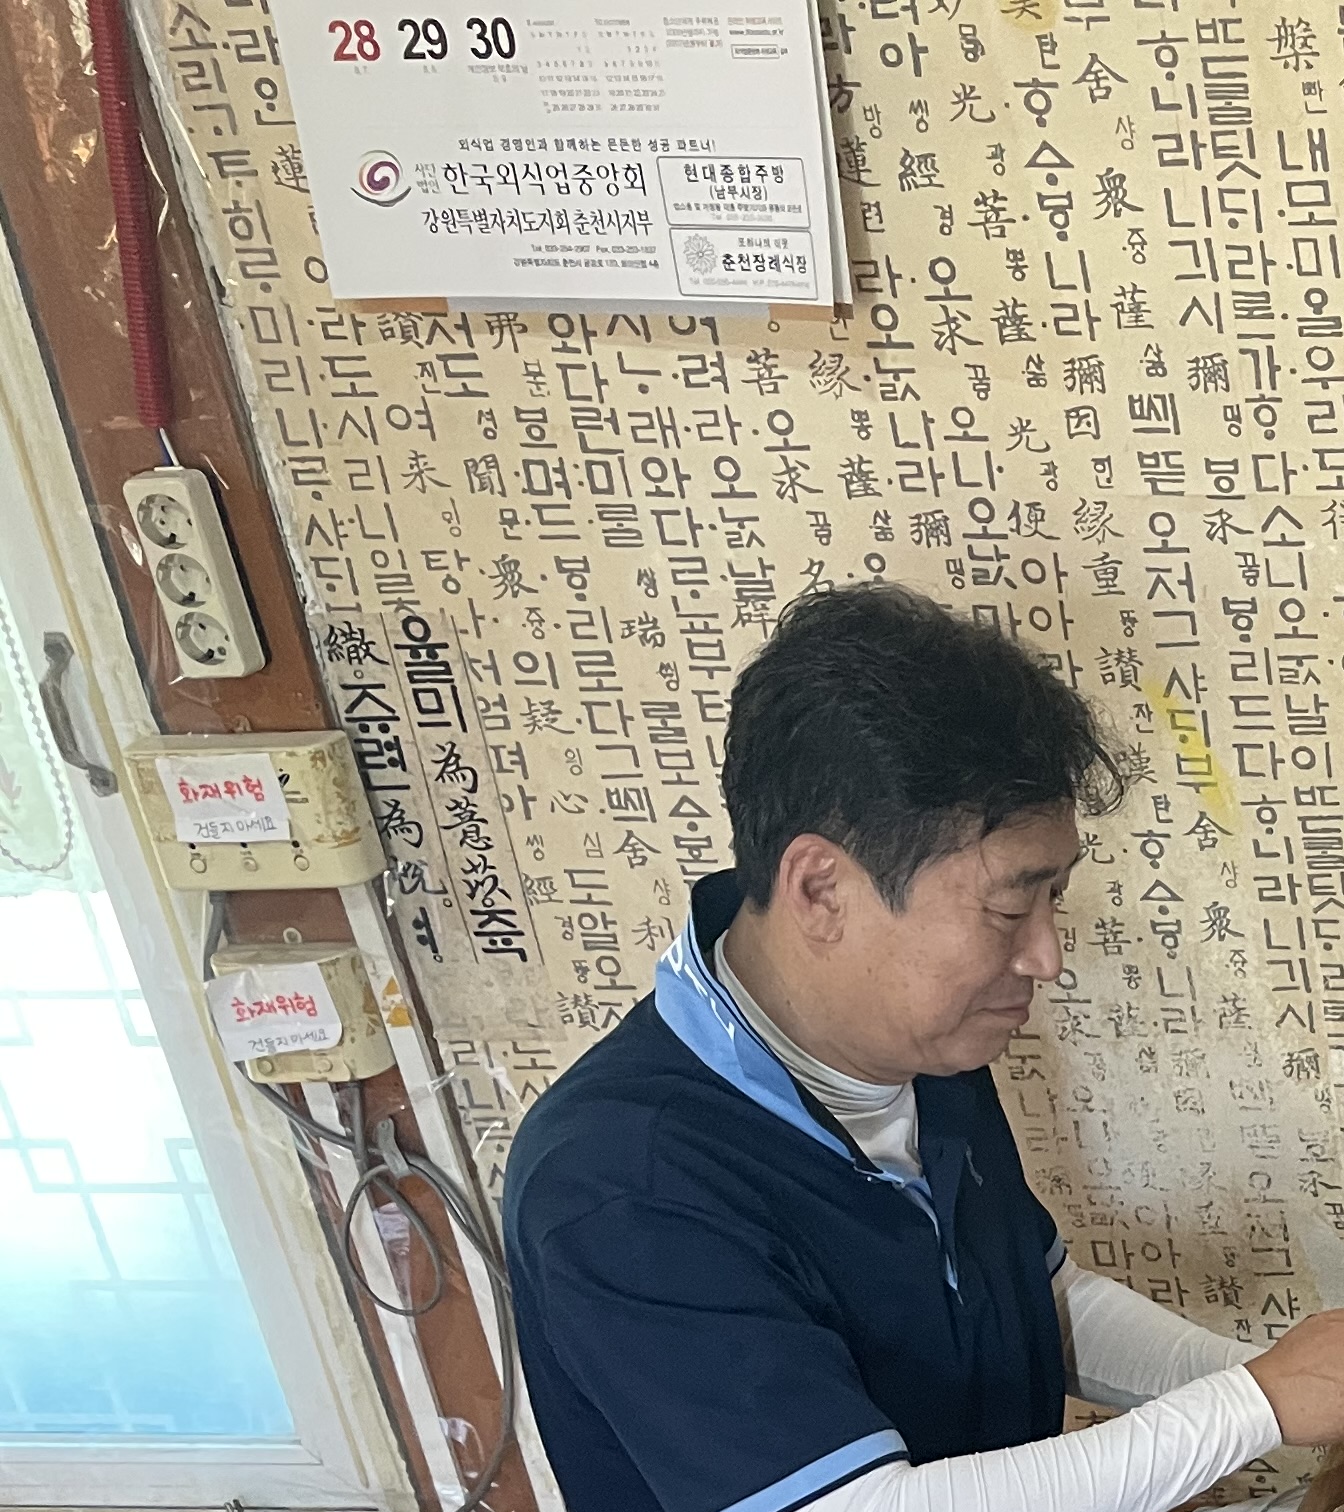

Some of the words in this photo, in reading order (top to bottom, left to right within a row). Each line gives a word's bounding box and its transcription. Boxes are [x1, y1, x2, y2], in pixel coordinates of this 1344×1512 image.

[328, 20, 381, 61] 28
[397, 18, 448, 60] 29
[466, 17, 517, 60] 30
[458, 138, 494, 151] 외식업
[441, 162, 649, 198] 한국외식업중앙회
[684, 163, 785, 185] 현대종합주방
[421, 207, 571, 235] 강원특별자치도지회
[574, 208, 655, 237] 춘천시지부
[721, 252, 807, 275] 춘천장례식장
[177, 775, 265, 804] 화재위험
[231, 991, 319, 1023] 화재위험
